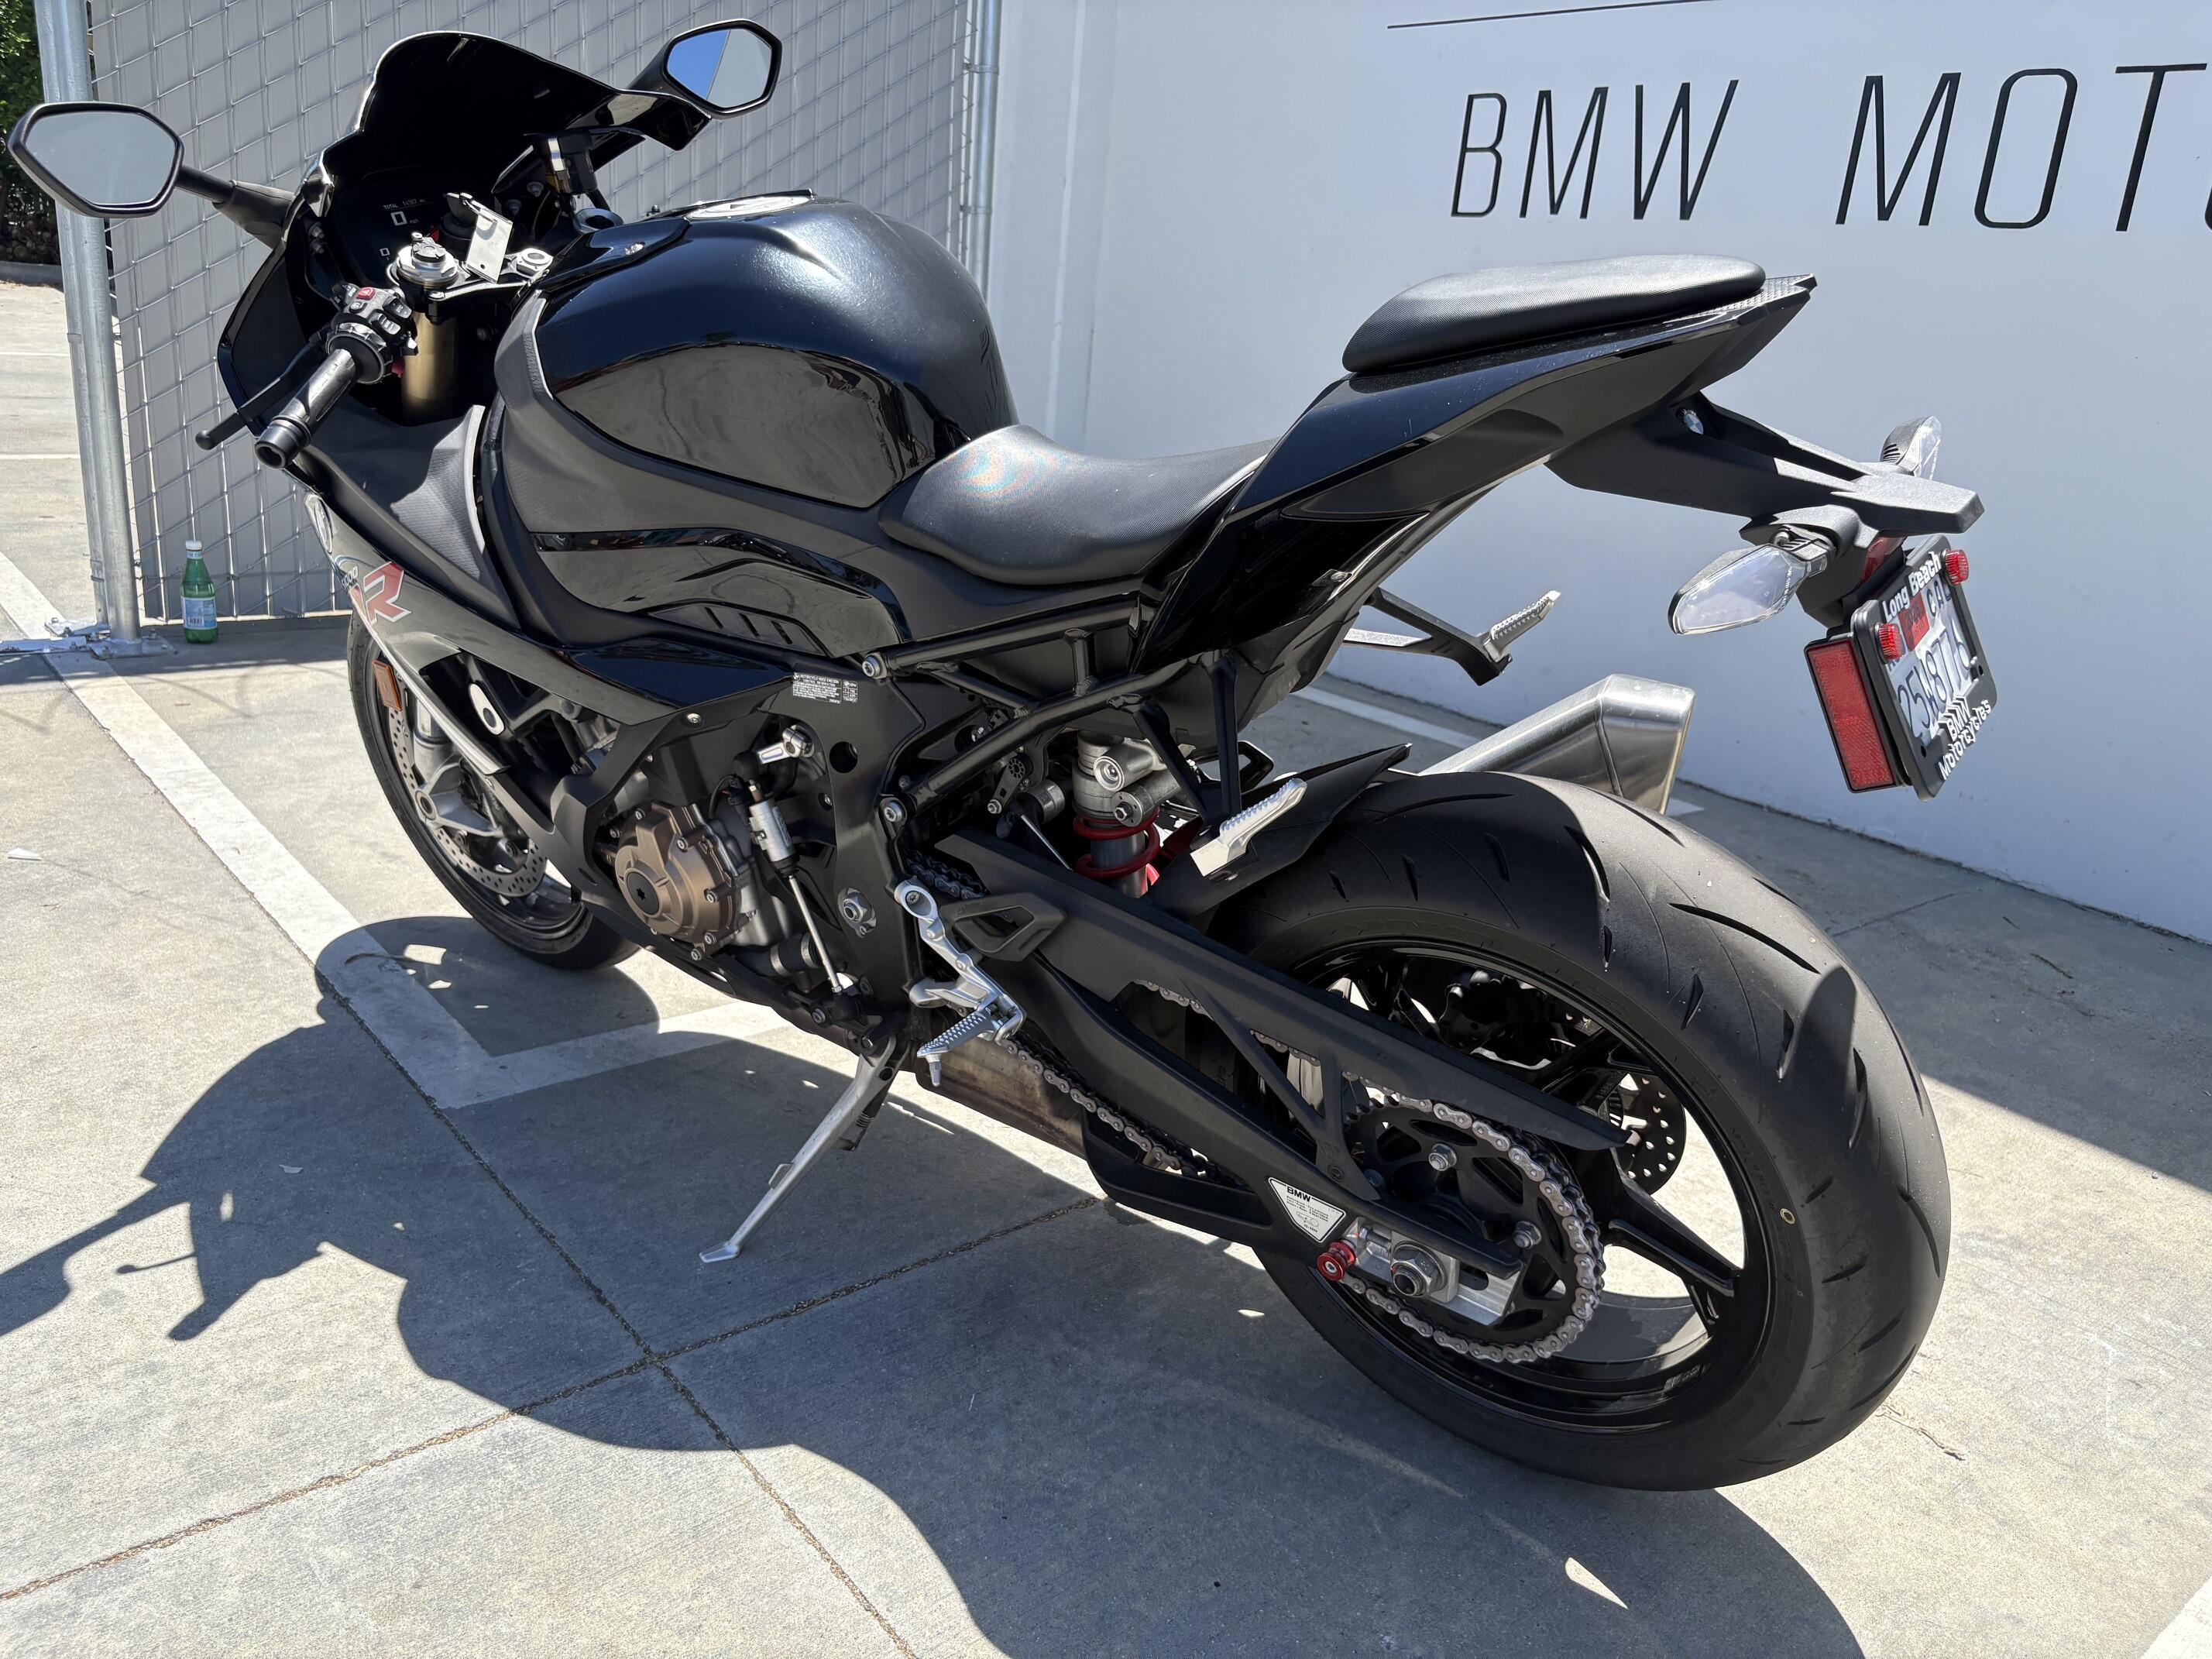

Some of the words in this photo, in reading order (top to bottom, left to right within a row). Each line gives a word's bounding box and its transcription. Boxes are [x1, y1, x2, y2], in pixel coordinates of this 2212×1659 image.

[1450, 79, 1740, 220] BMW
[1835, 63, 2212, 232] MOT
[390, 211, 407, 226] 0
[1882, 586, 1911, 623] Long
[1908, 551, 1942, 596] Beach
[1898, 617, 1970, 738] 25W8776
[1938, 699, 1991, 781] Motorcycles
[1946, 696, 1971, 742] BMW
[1286, 1186, 1311, 1202] BMW
